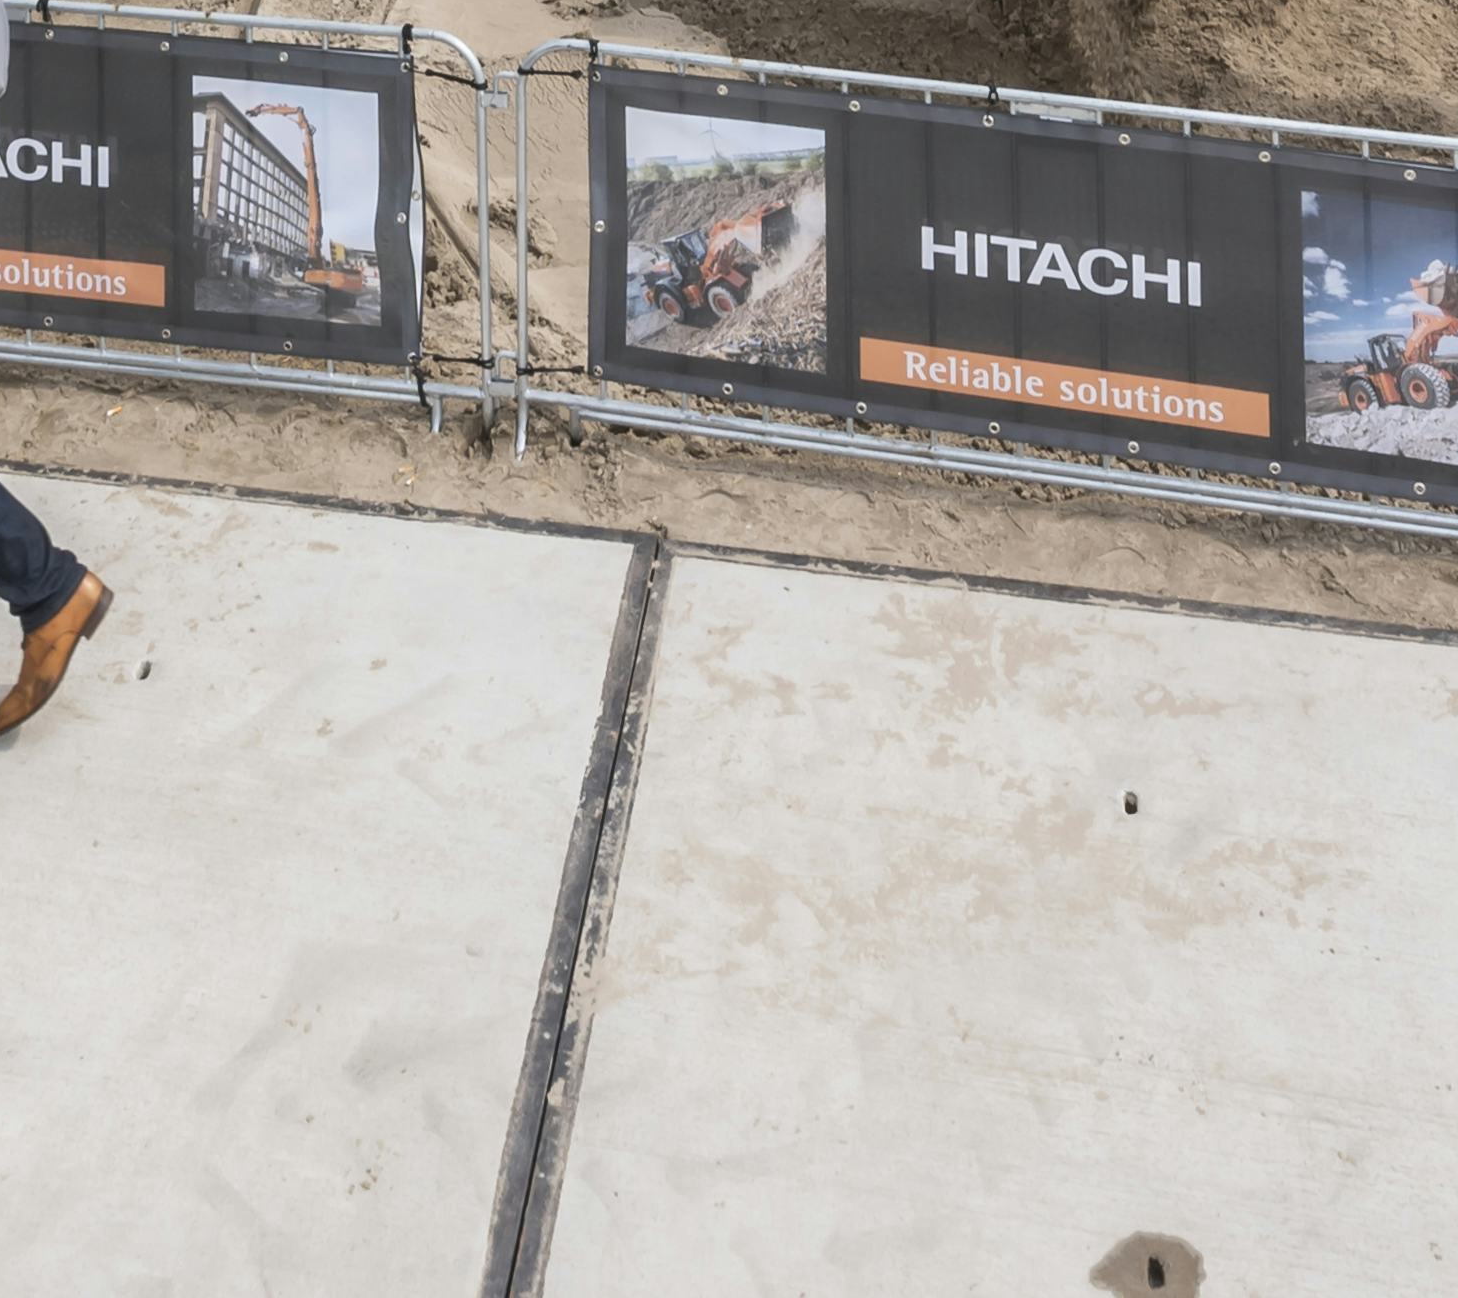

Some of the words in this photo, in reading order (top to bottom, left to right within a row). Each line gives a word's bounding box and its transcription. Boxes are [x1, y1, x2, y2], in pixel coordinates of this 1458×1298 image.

[921, 225, 1202, 307] HITACHI
[904, 349, 1045, 399] Reliable
[1059, 373, 1225, 424] solutions
